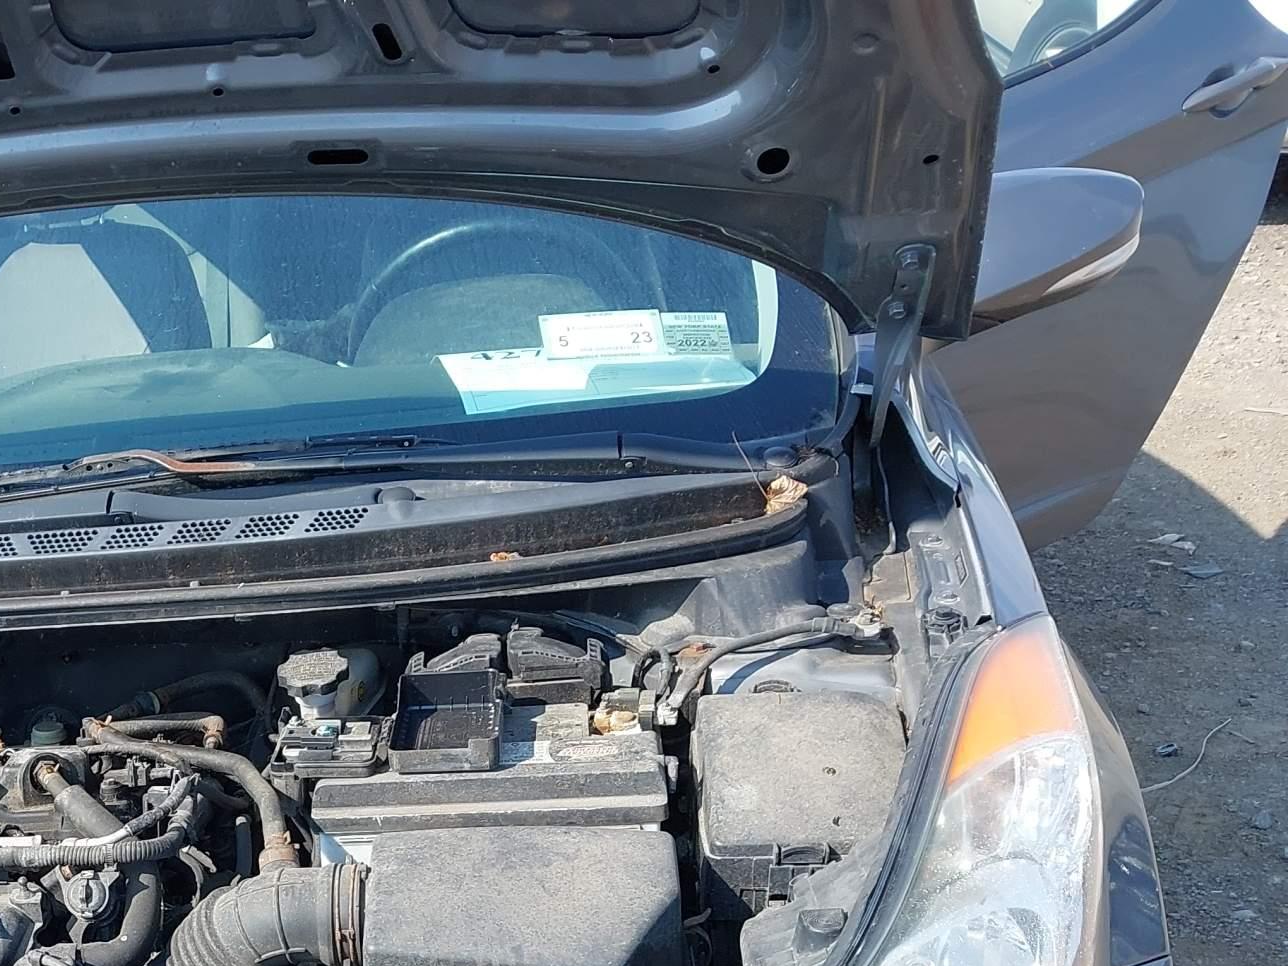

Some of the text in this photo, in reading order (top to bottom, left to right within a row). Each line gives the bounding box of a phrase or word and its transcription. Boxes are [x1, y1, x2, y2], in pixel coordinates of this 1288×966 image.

[558, 335, 569, 347] 5
[630, 331, 653, 344] 23
[677, 339, 707, 347] 2022
